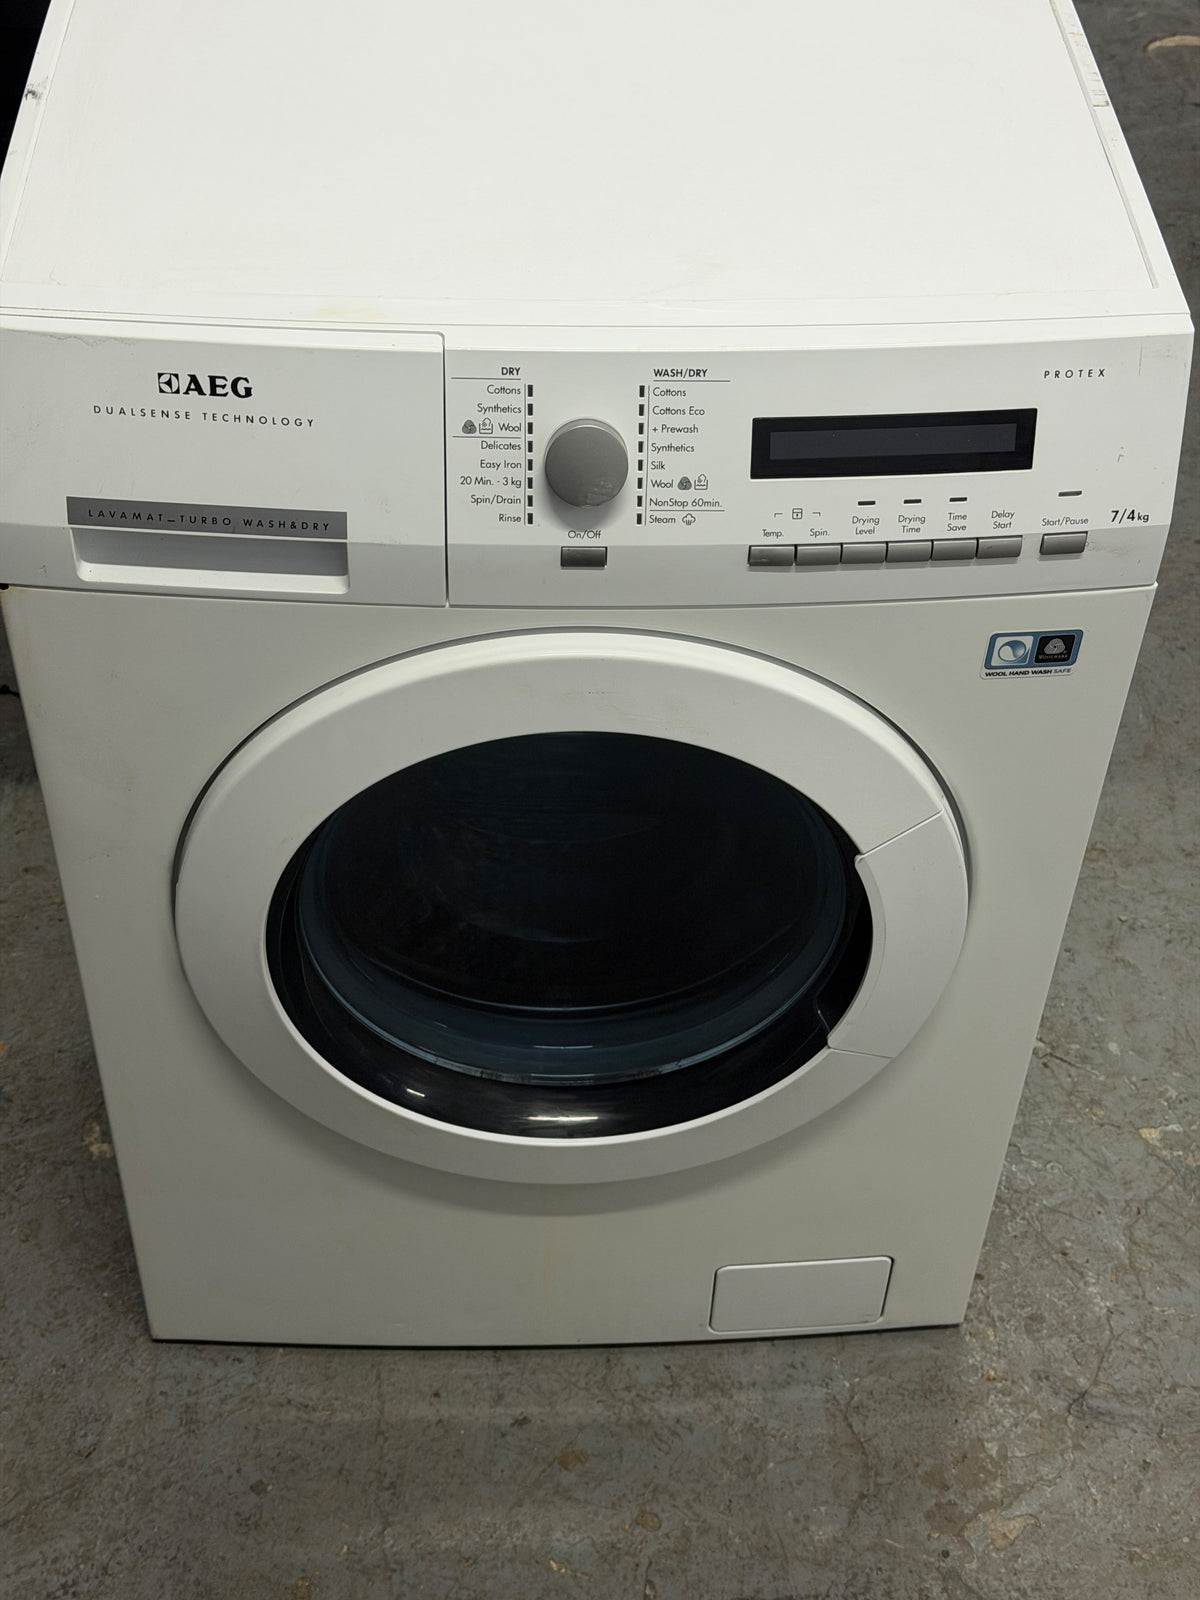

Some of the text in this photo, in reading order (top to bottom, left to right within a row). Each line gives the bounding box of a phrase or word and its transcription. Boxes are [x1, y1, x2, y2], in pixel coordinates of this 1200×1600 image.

[501, 367, 521, 376] DRY
[653, 369, 708, 378] WASH/DRY
[1043, 369, 1106, 379] PROTEX
[183, 374, 253, 398] AEG
[487, 385, 521, 395] Cottons
[653, 387, 687, 397] Cottons
[477, 403, 522, 414] Synthetics
[652, 405, 706, 416] Cottons Eco
[93, 404, 315, 428] DUALSENSE TECHNOLOGY
[498, 422, 522, 433] Wool
[661, 424, 699, 434] Prewash
[481, 440, 522, 451] Delicates
[651, 443, 695, 453] Synthetics
[480, 459, 522, 471] Easy Iron
[651, 461, 666, 470] Silk
[460, 477, 471, 486] 20
[474, 477, 494, 486] Min.
[502, 477, 508, 486] 3
[511, 476, 522, 488] kg
[651, 479, 674, 489] Wool
[470, 495, 522, 506] Spin/Drain
[650, 498, 723, 508] NonStop 60min.
[498, 514, 522, 523] Rinse
[649, 515, 676, 524] Steam
[897, 514, 926, 526] Drying
[947, 512, 967, 522] Time
[991, 510, 1015, 520] Delay
[243, 518, 331, 532] WASH&DRY
[851, 515, 880, 526] Drying
[992, 519, 1012, 530] Start
[1041, 515, 1089, 526] Start/Pause
[855, 526, 876, 536] Level
[901, 524, 921, 534] Time
[946, 522, 967, 532] Save
[567, 530, 602, 540] On/Off
[761, 528, 785, 538] Temp.
[809, 528, 830, 538] Spin.
